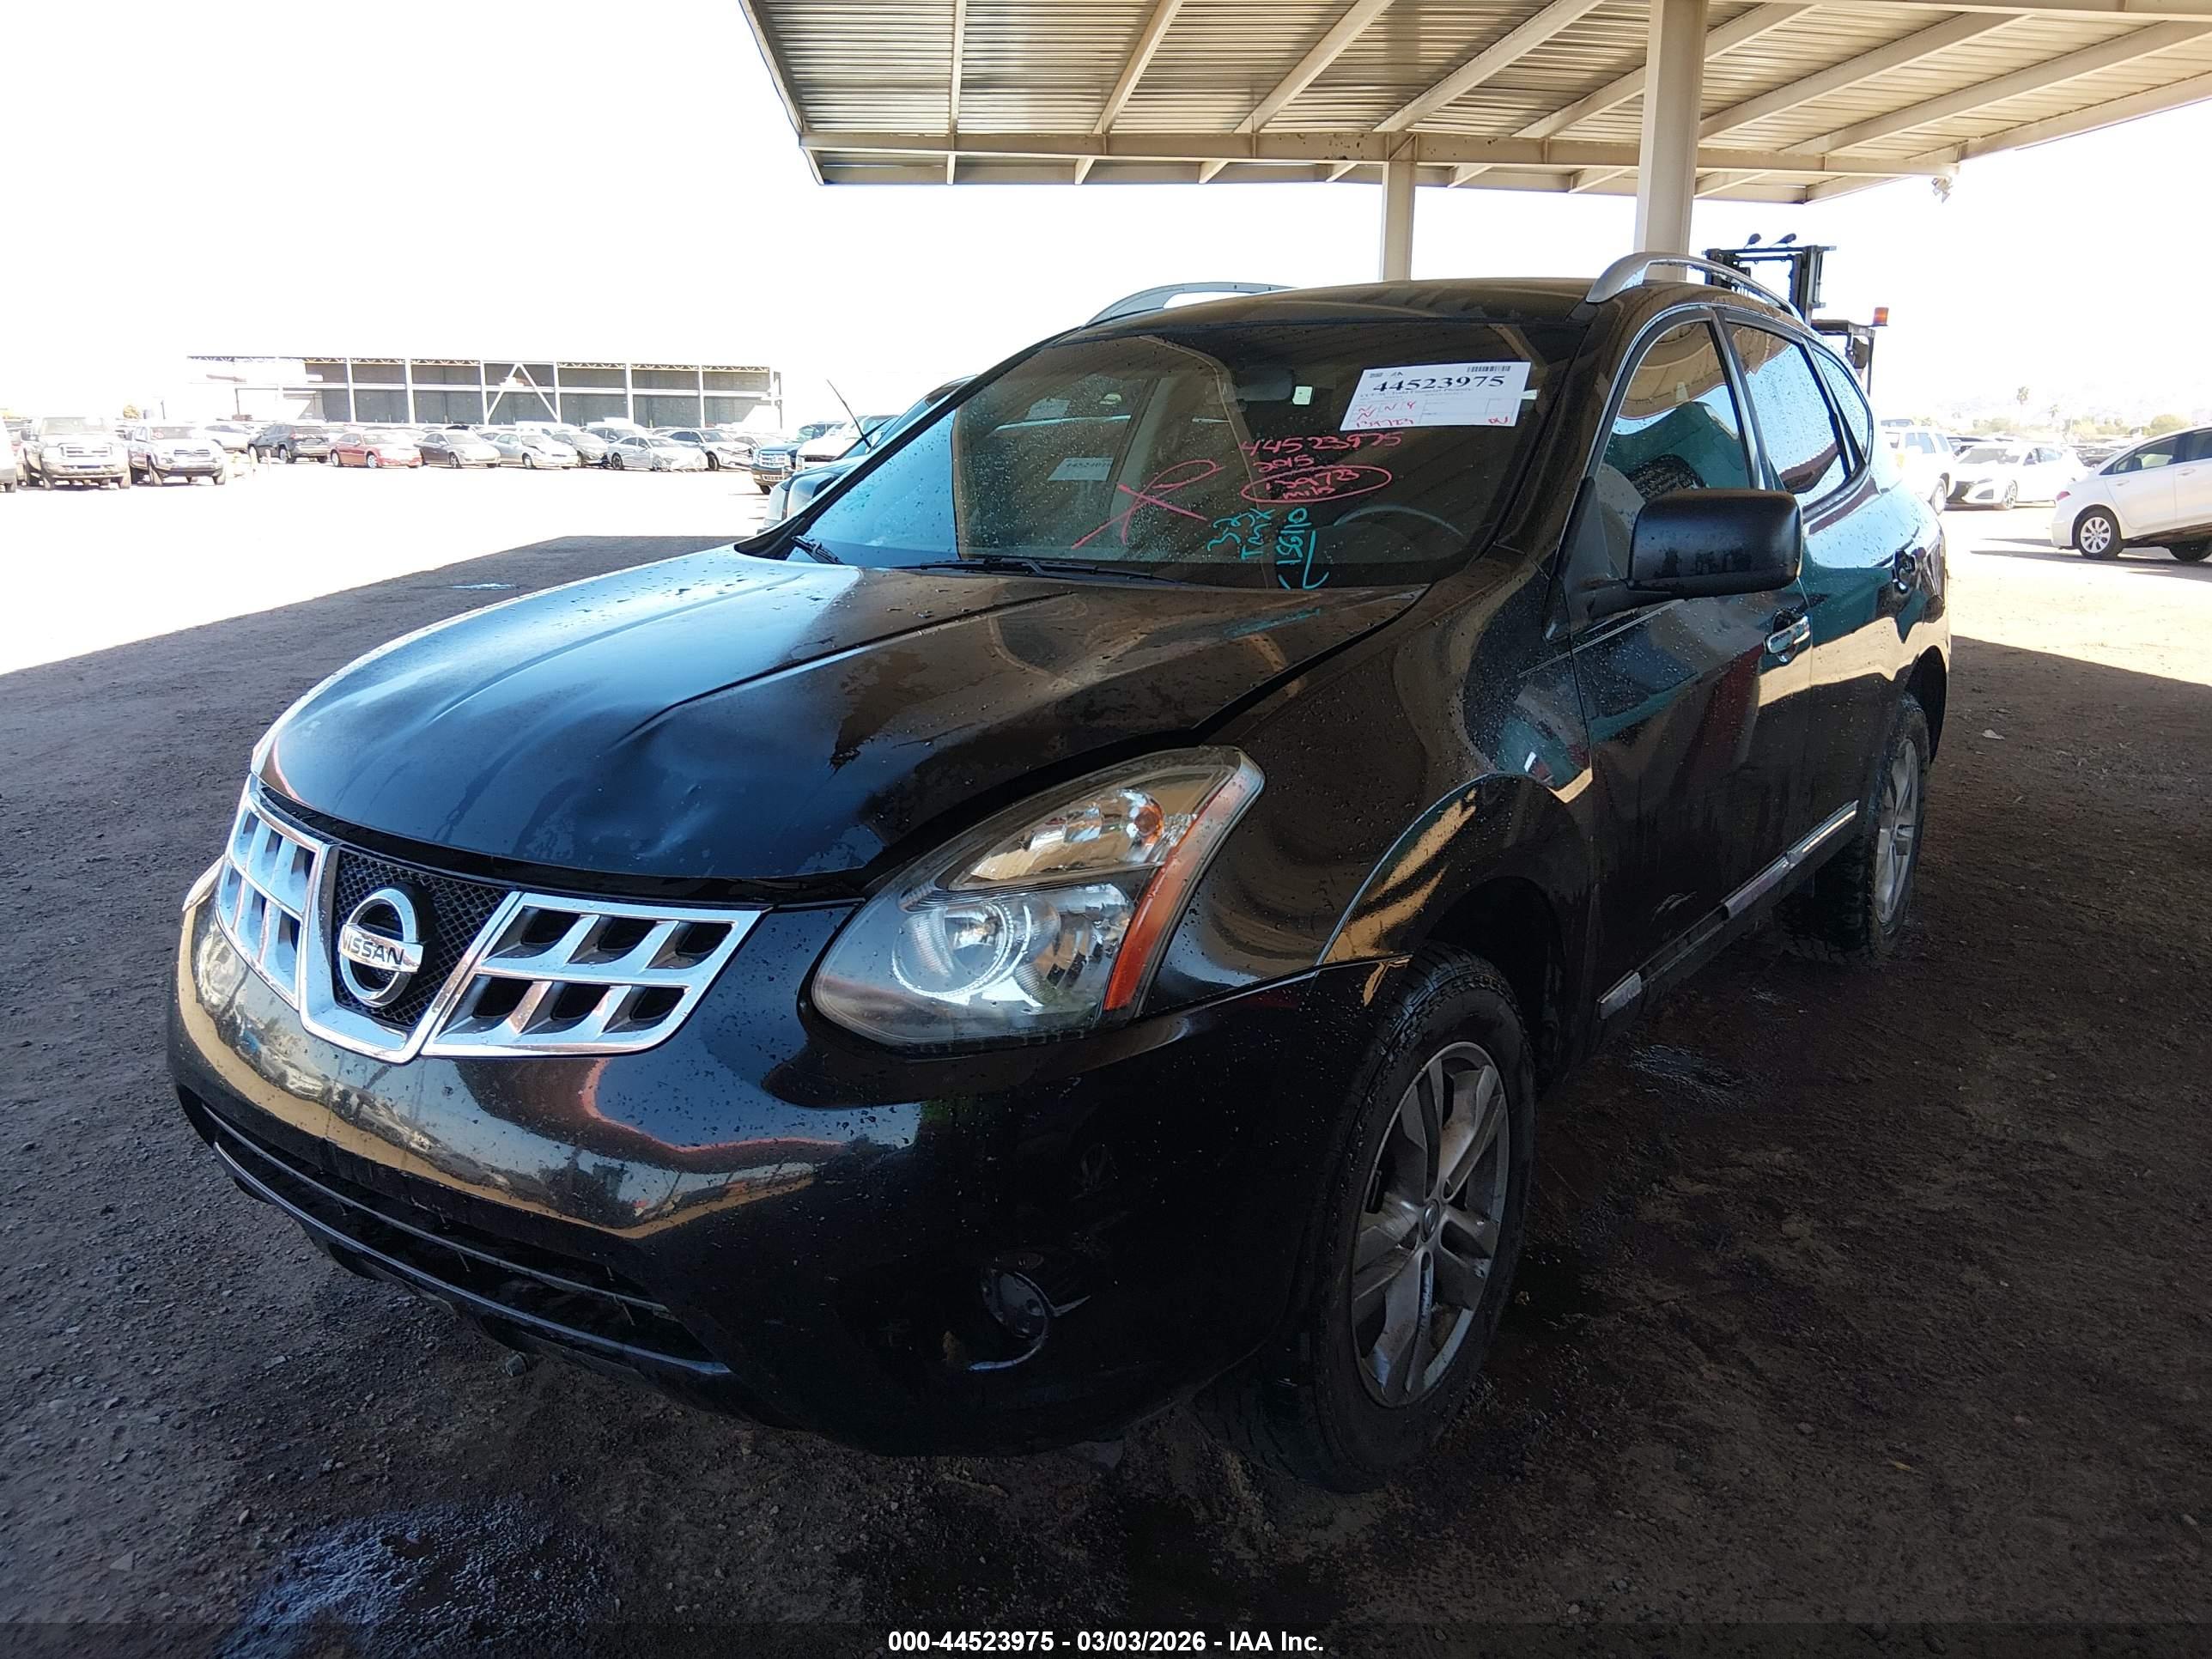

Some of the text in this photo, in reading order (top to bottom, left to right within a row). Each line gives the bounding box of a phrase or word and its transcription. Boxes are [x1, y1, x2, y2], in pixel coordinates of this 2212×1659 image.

[1373, 375, 1504, 392] 44523975
[1241, 432, 1404, 456] 44523975
[1253, 454, 1314, 473] 2015
[342, 929, 405, 965] NISSAN
